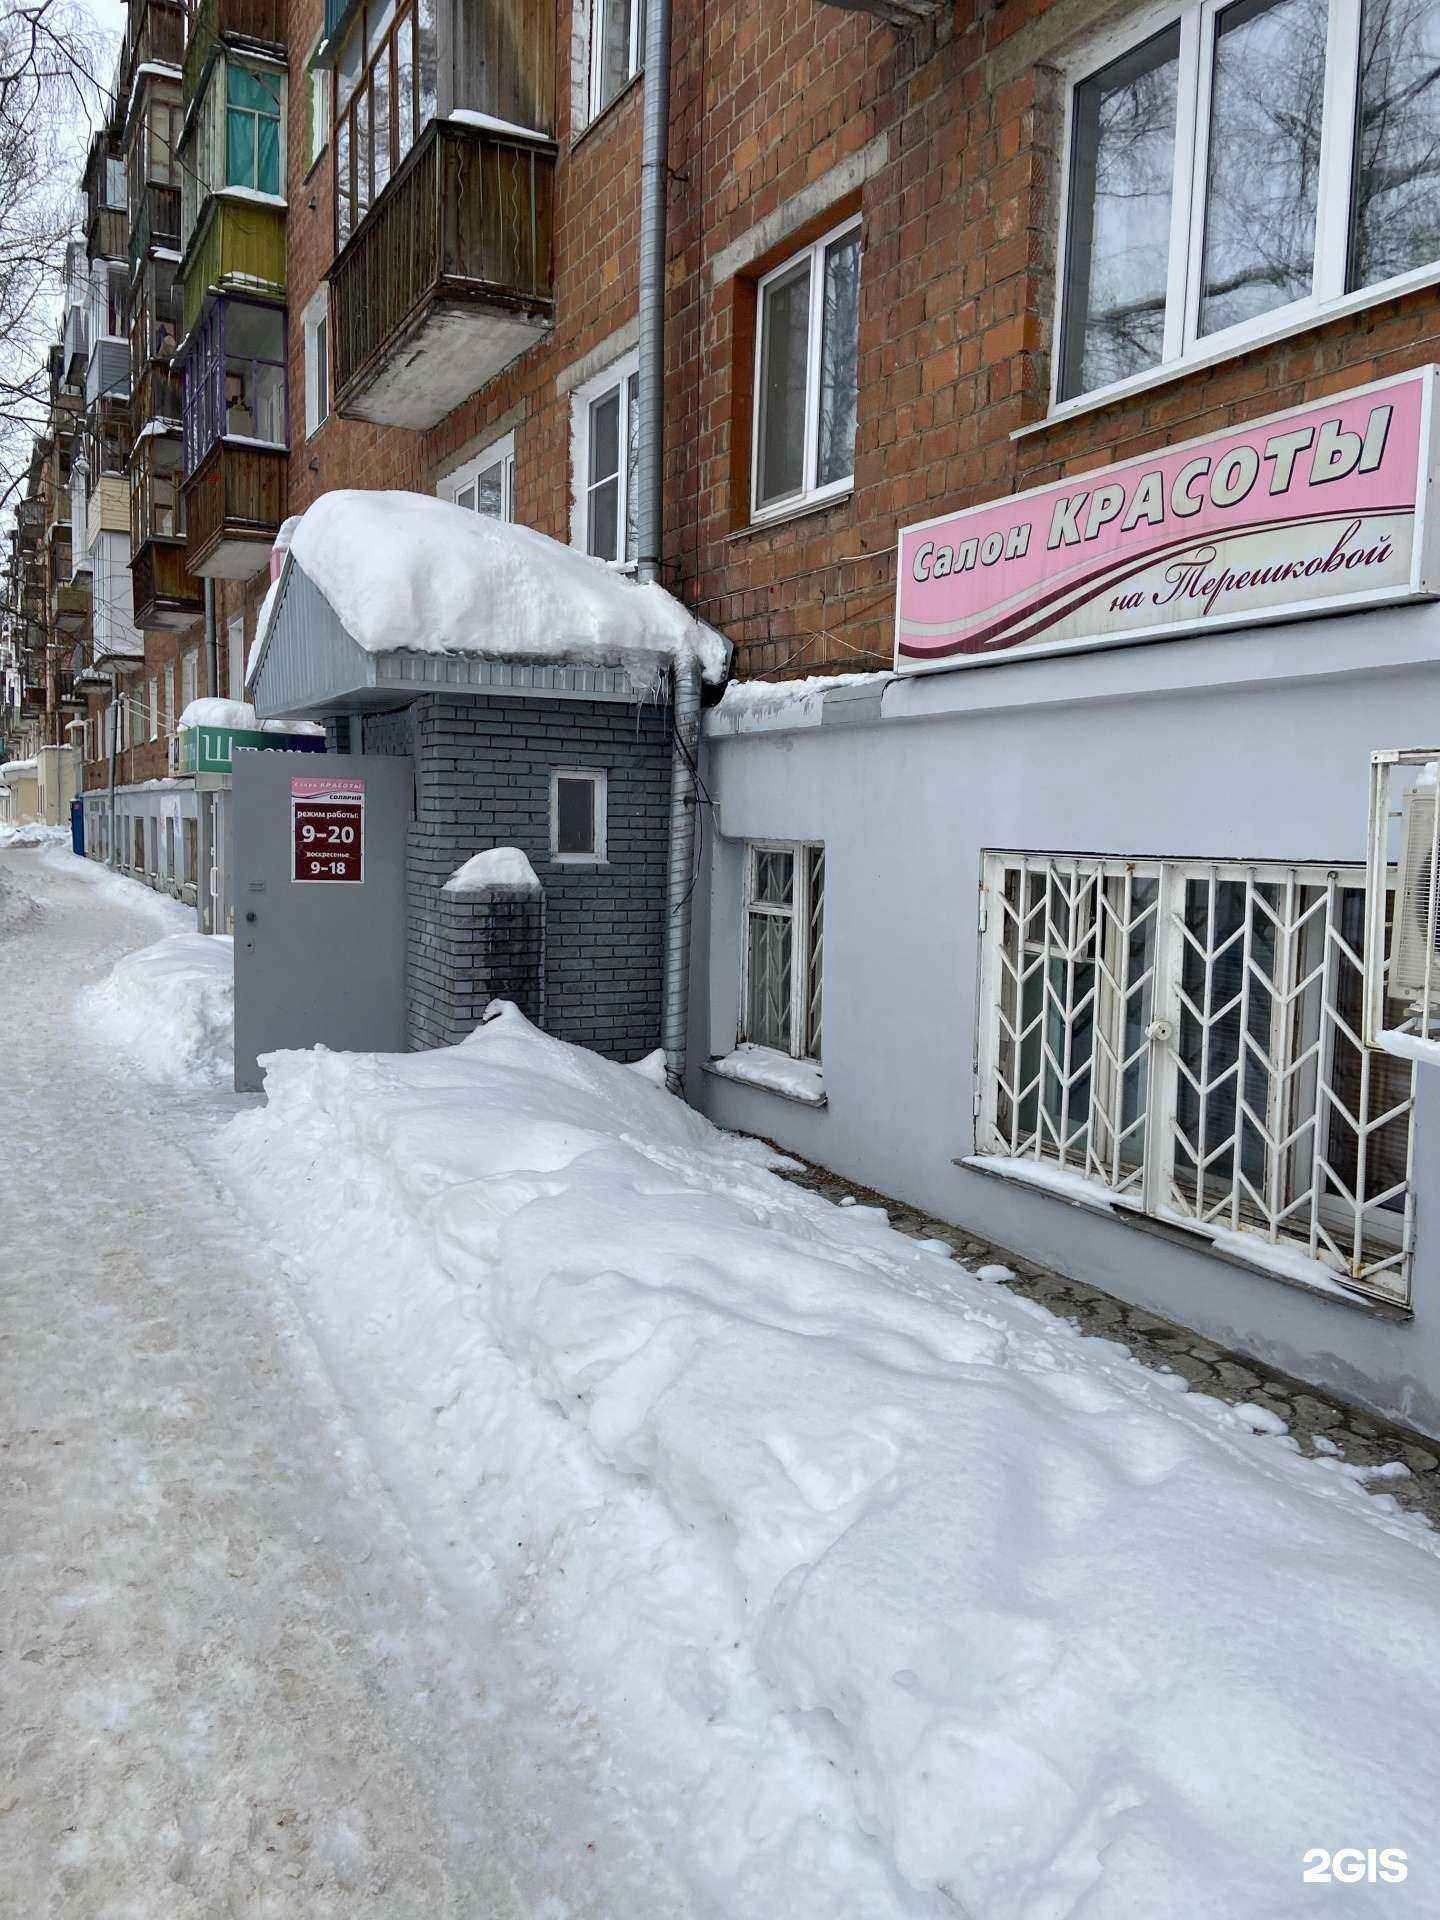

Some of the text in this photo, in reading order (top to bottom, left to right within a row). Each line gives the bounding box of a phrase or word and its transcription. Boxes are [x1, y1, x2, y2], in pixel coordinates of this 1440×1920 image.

[912, 404, 1395, 583] Салон КРАСОТЫ
[1109, 518, 1394, 615] на Терешковой
[297, 810, 326, 819] режим
